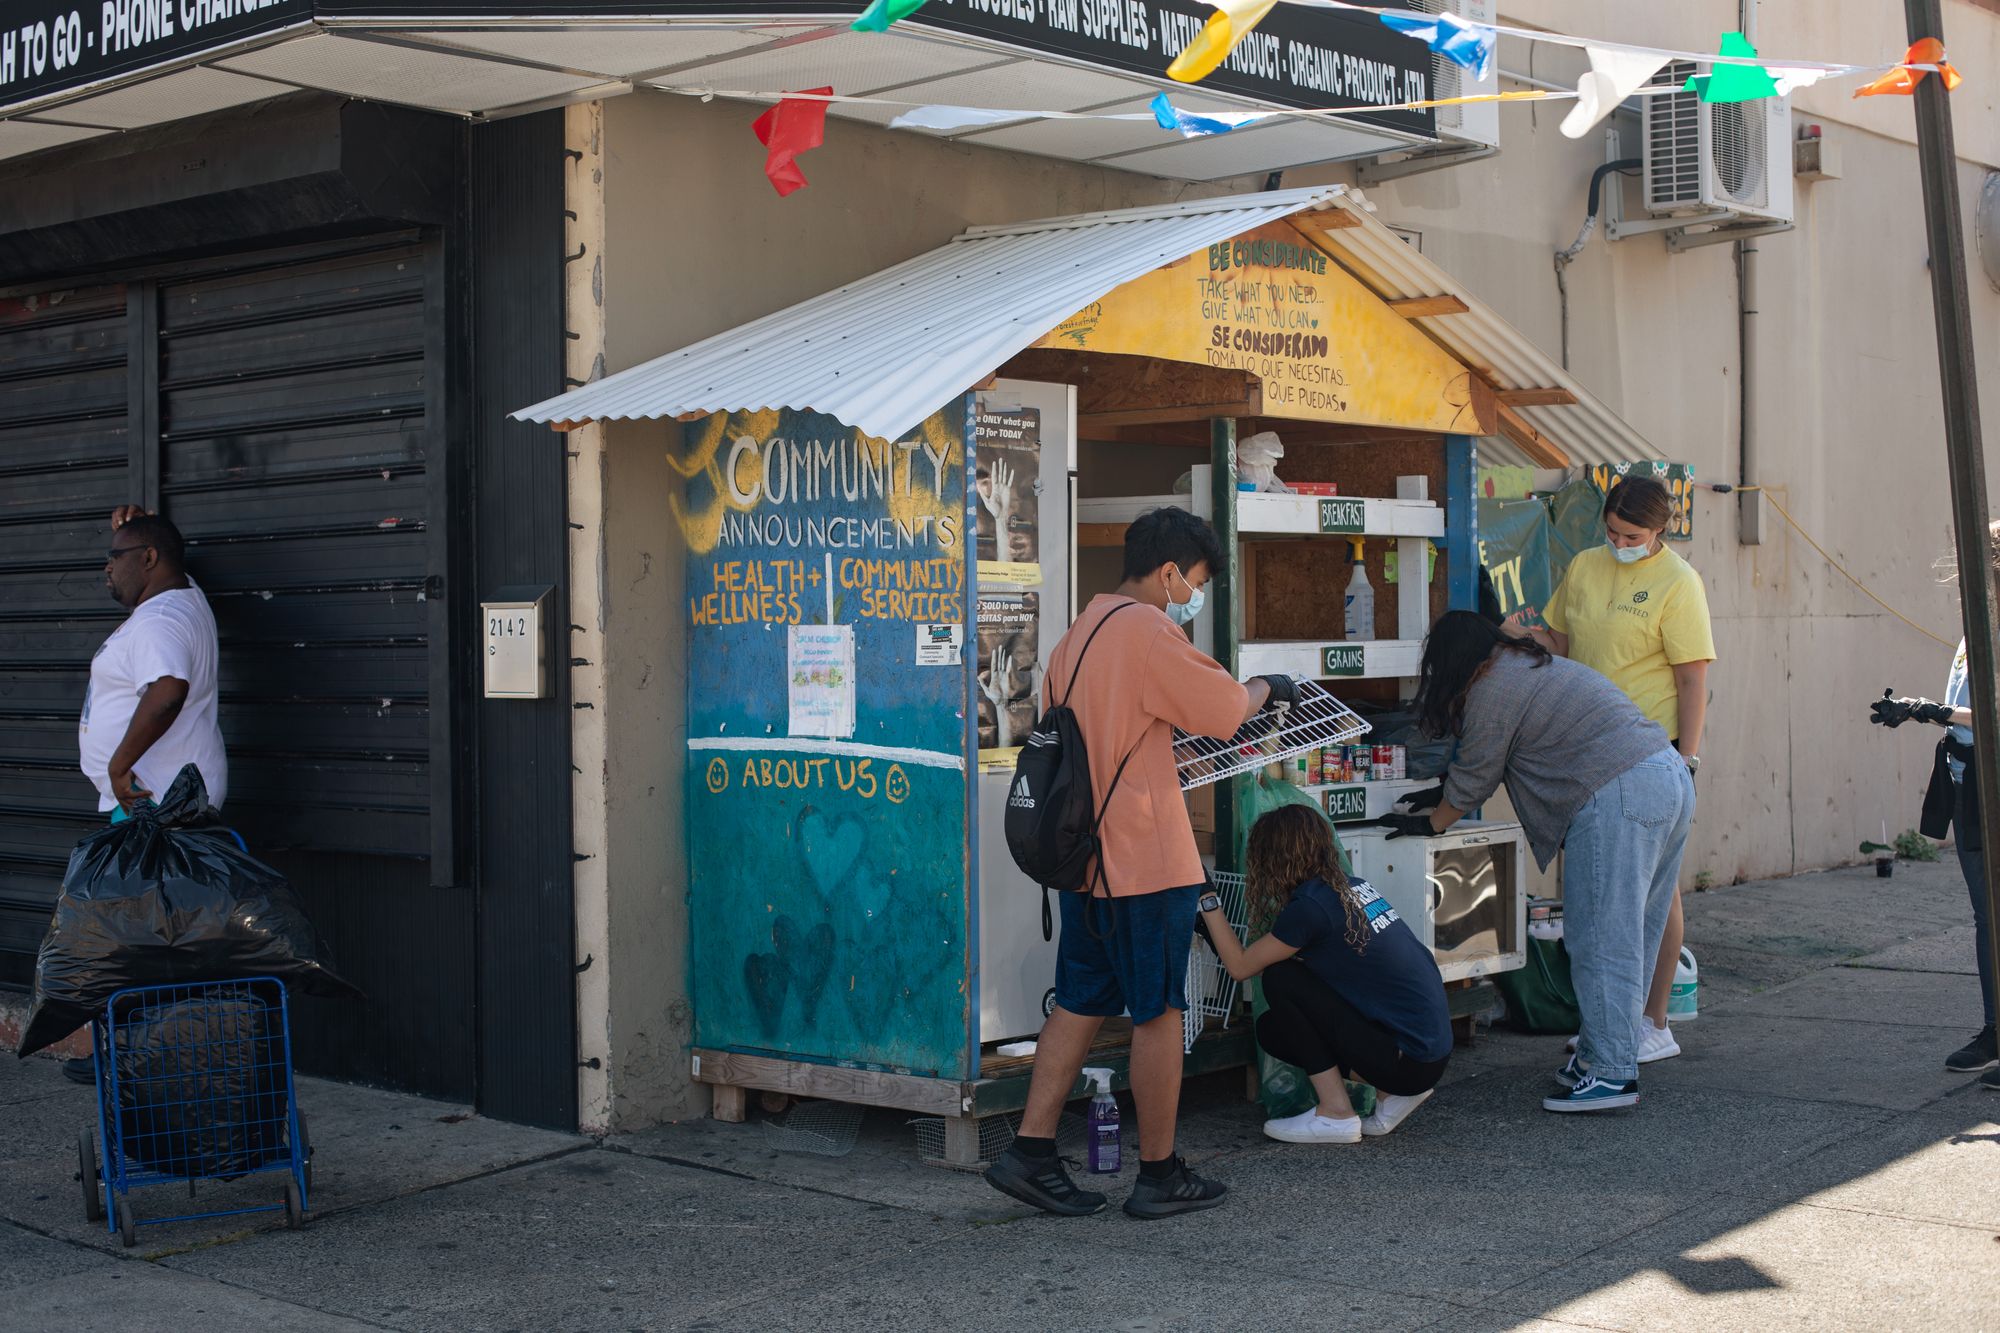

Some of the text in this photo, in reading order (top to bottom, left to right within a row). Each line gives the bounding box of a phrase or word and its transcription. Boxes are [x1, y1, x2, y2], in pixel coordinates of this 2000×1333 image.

[0, 30, 16, 85] H
[21, 21, 48, 76] TO
[52, 10, 82, 71] GO
[101, 0, 174, 56] PHONE
[1049, 0, 1080, 33] RAW
[1082, 0, 1149, 51] SUPPLIES
[1159, 9, 1209, 58] NATU
[1289, 39, 1342, 96] ORGANIC
[1343, 54, 1397, 106] PRODUCT
[1404, 69, 1426, 114] ATM
[1209, 239, 1327, 275] BE CONSIDERATE
[1197, 278, 1230, 301] TAKE
[1234, 282, 1262, 302] WHAT
[1265, 284, 1285, 302] YOU
[1202, 300, 1228, 321] GIVE
[1234, 305, 1262, 325] WHAT
[1265, 307, 1286, 329] YOU
[1212, 325, 1329, 360] SE CONSIDERADO
[1261, 358, 1285, 379] QUE
[1268, 381, 1294, 403] QUE
[975, 427, 1023, 440] ED for TODAY
[982, 414, 1002, 425] ONLY
[1003, 417, 1021, 427] what
[1021, 420, 1036, 430] you
[727, 435, 951, 505] COMMUNITY
[1322, 503, 1364, 527] BREAKFAST
[717, 512, 957, 549] ANNOUNCEMENTS
[839, 557, 964, 592] COMMUNITY
[691, 592, 802, 625] WELLNESS
[860, 588, 963, 624] SERVICES
[976, 613, 1035, 624] ESITAS para HOY
[982, 601, 1001, 610] SOLO
[1010, 603, 1023, 612] que
[1617, 604, 1649, 618] UNITED
[490, 618, 525, 636] 2142
[1327, 649, 1364, 669] GRAINS
[742, 758, 877, 798] ABOUT US
[1328, 790, 1365, 816] BEANS
[1370, 914, 1392, 934] FOR
